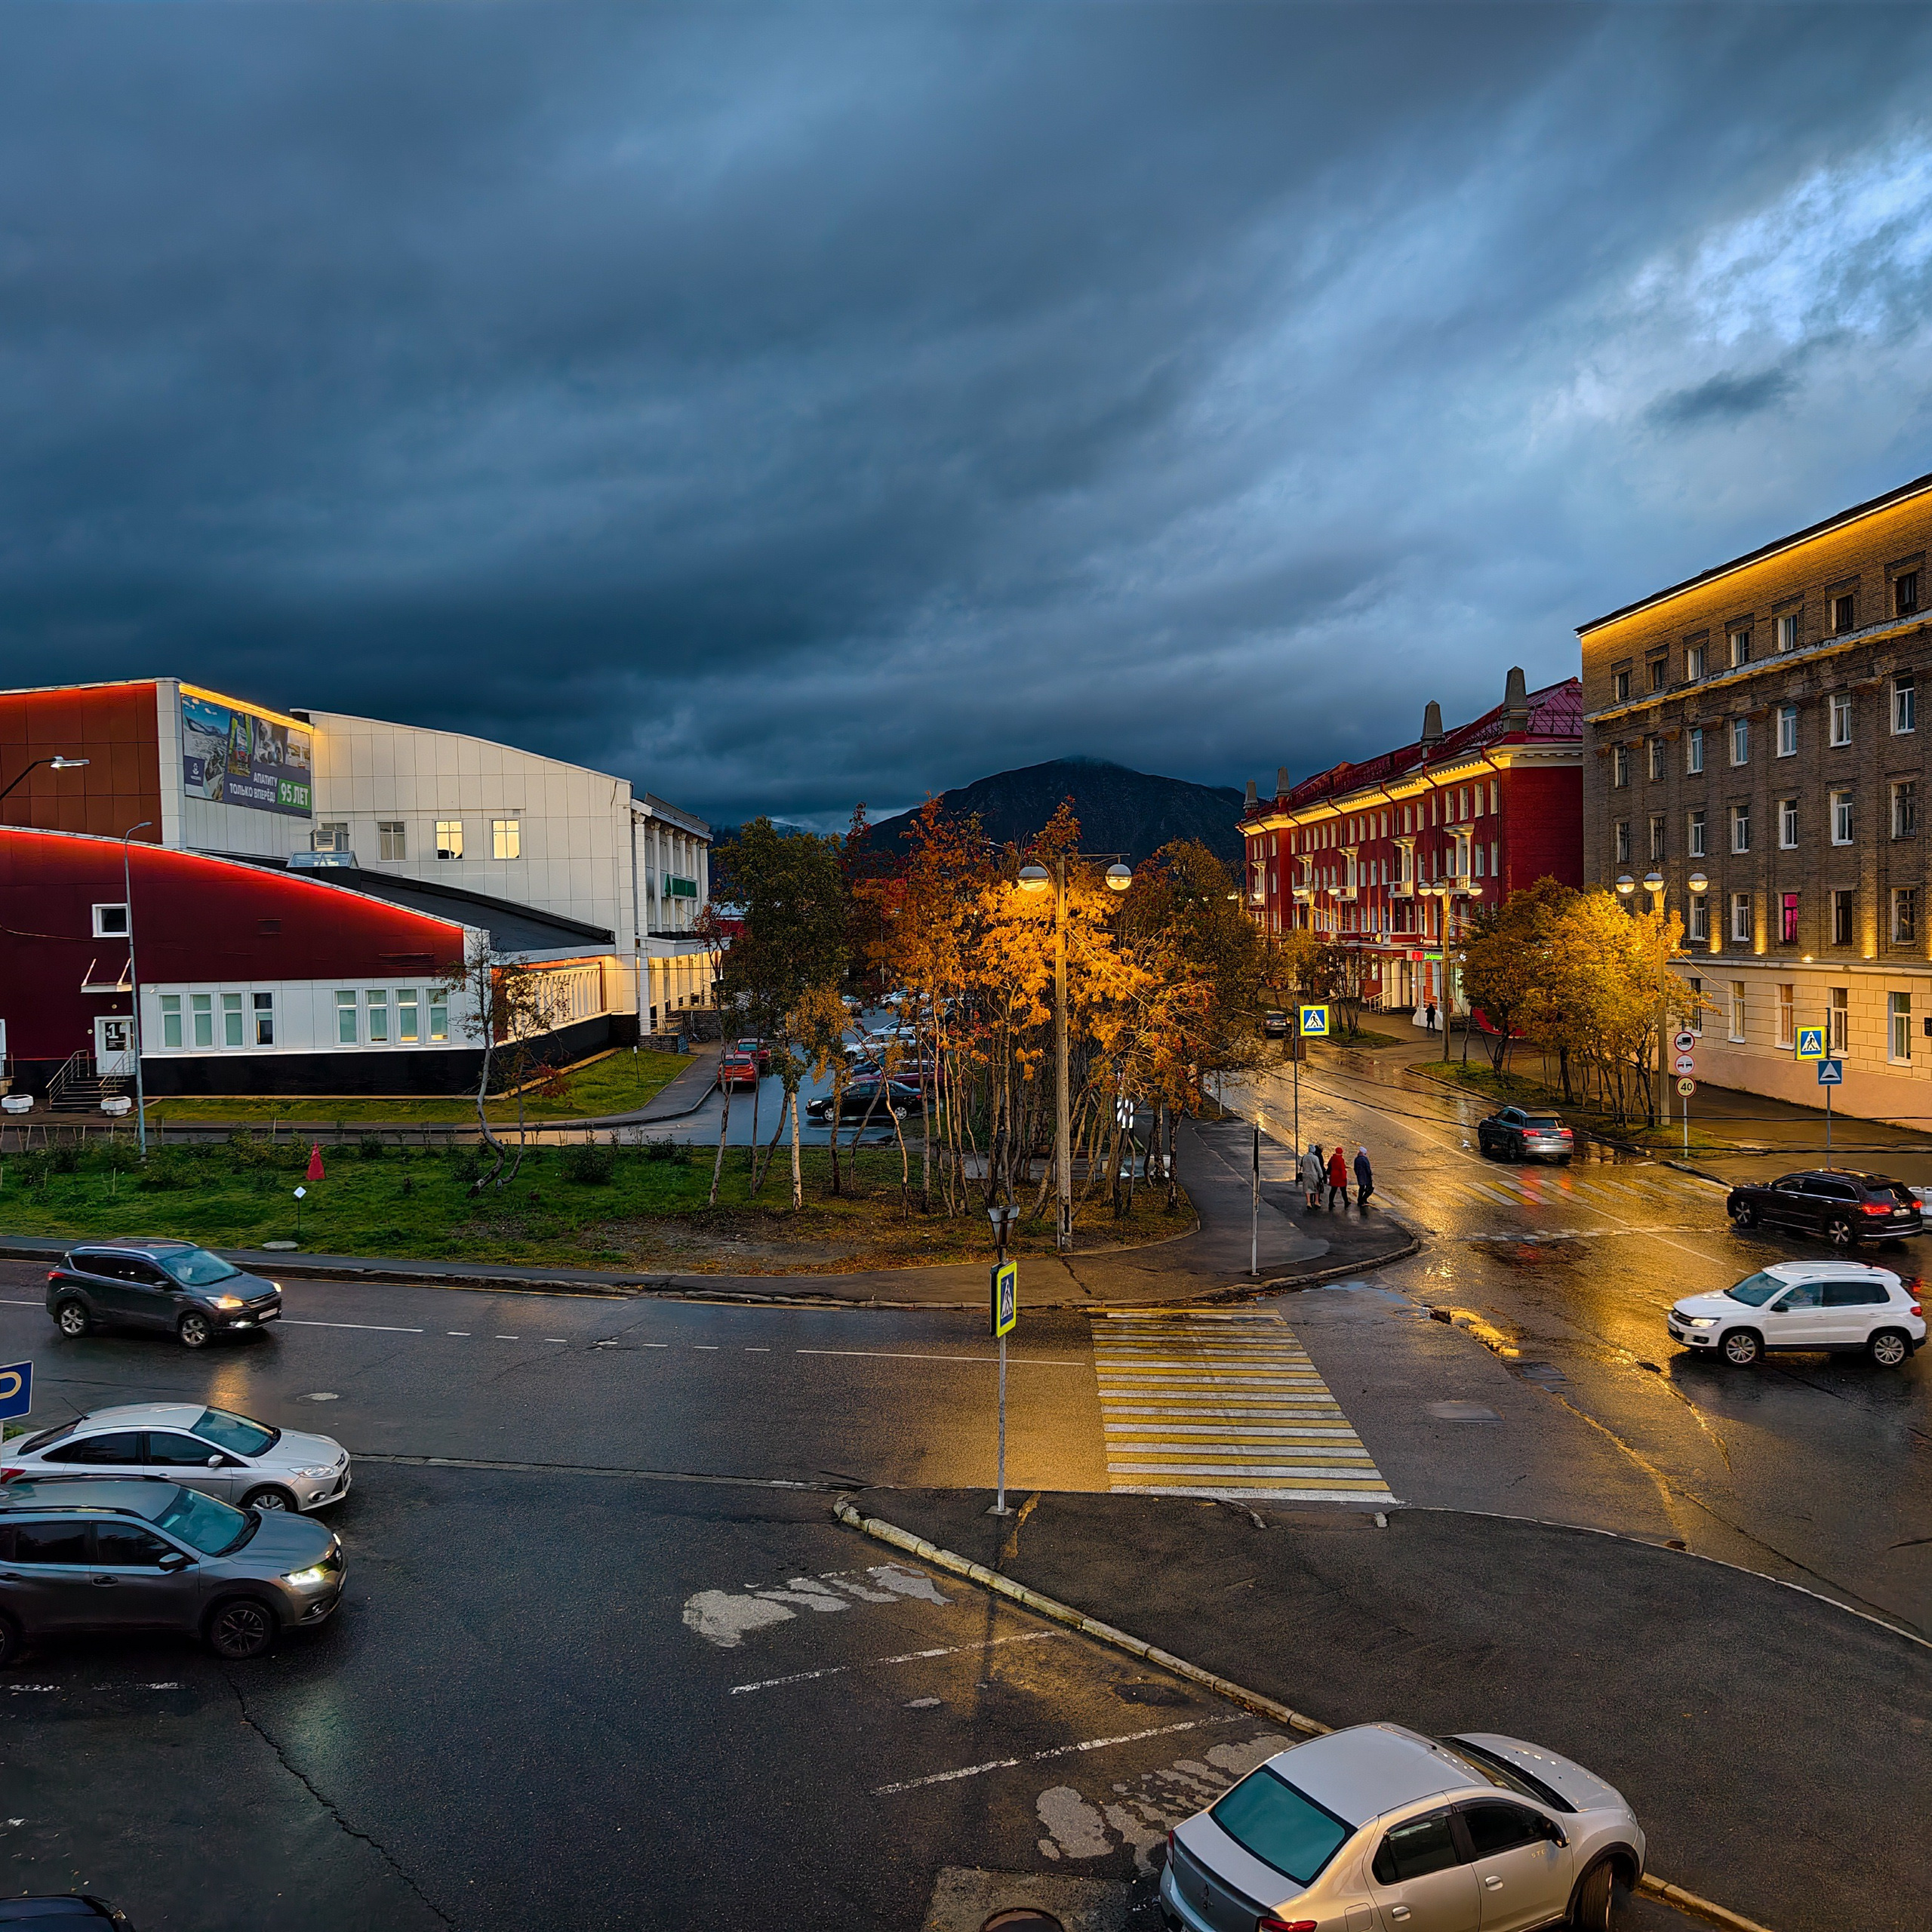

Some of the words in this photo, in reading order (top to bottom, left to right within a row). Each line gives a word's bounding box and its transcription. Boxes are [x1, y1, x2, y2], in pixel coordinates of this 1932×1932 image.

[253, 772, 278, 787] АПАТИТУ
[229, 783, 254, 798] ТОЛЬКО
[254, 788, 276, 804] ВПЕРЁД!
[281, 782, 292, 803] 95
[293, 786, 309, 806] ЛЕТ
[1681, 1082, 1693, 1091] 40
